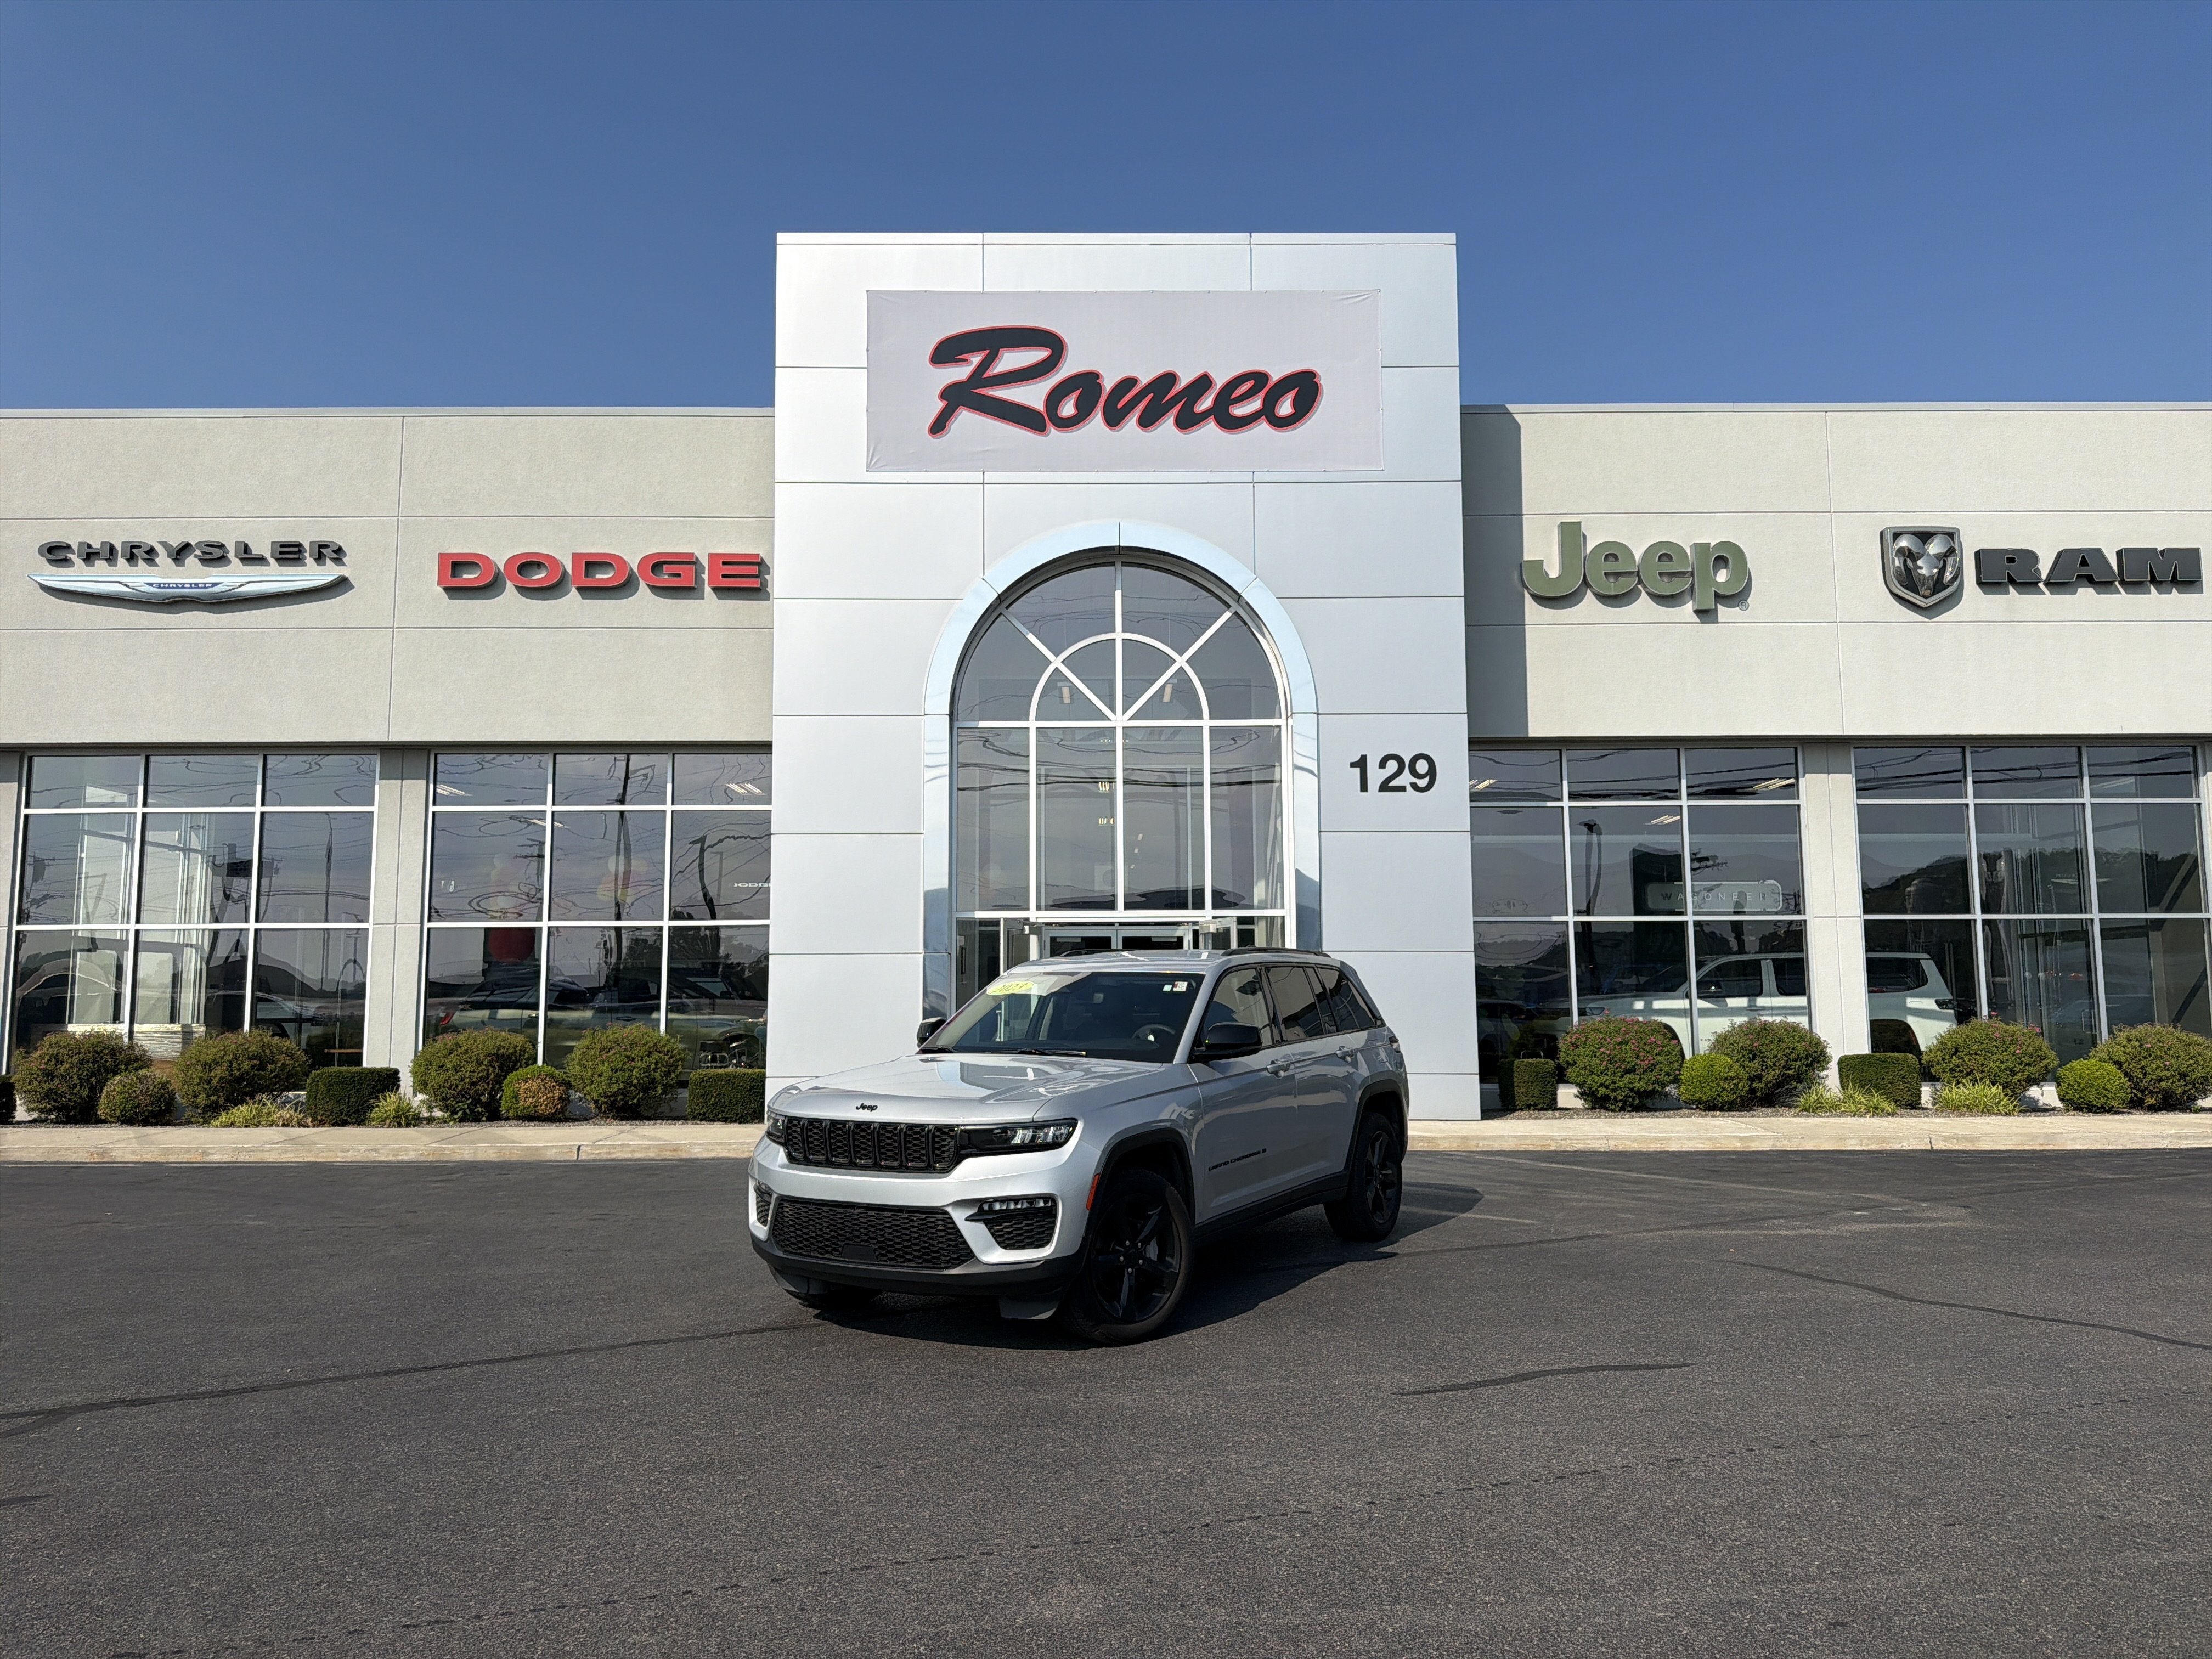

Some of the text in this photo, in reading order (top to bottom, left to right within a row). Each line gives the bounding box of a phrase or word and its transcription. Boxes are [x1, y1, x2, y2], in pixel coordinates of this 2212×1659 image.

[928, 325, 1323, 438] Romeo
[37, 540, 343, 561] CHRYSLER
[1522, 521, 1749, 613] Jeep
[1974, 547, 2204, 585] RAM
[437, 552, 762, 588] DODGE
[1350, 753, 1437, 793] 129
[856, 1102, 878, 1112] Jeep
